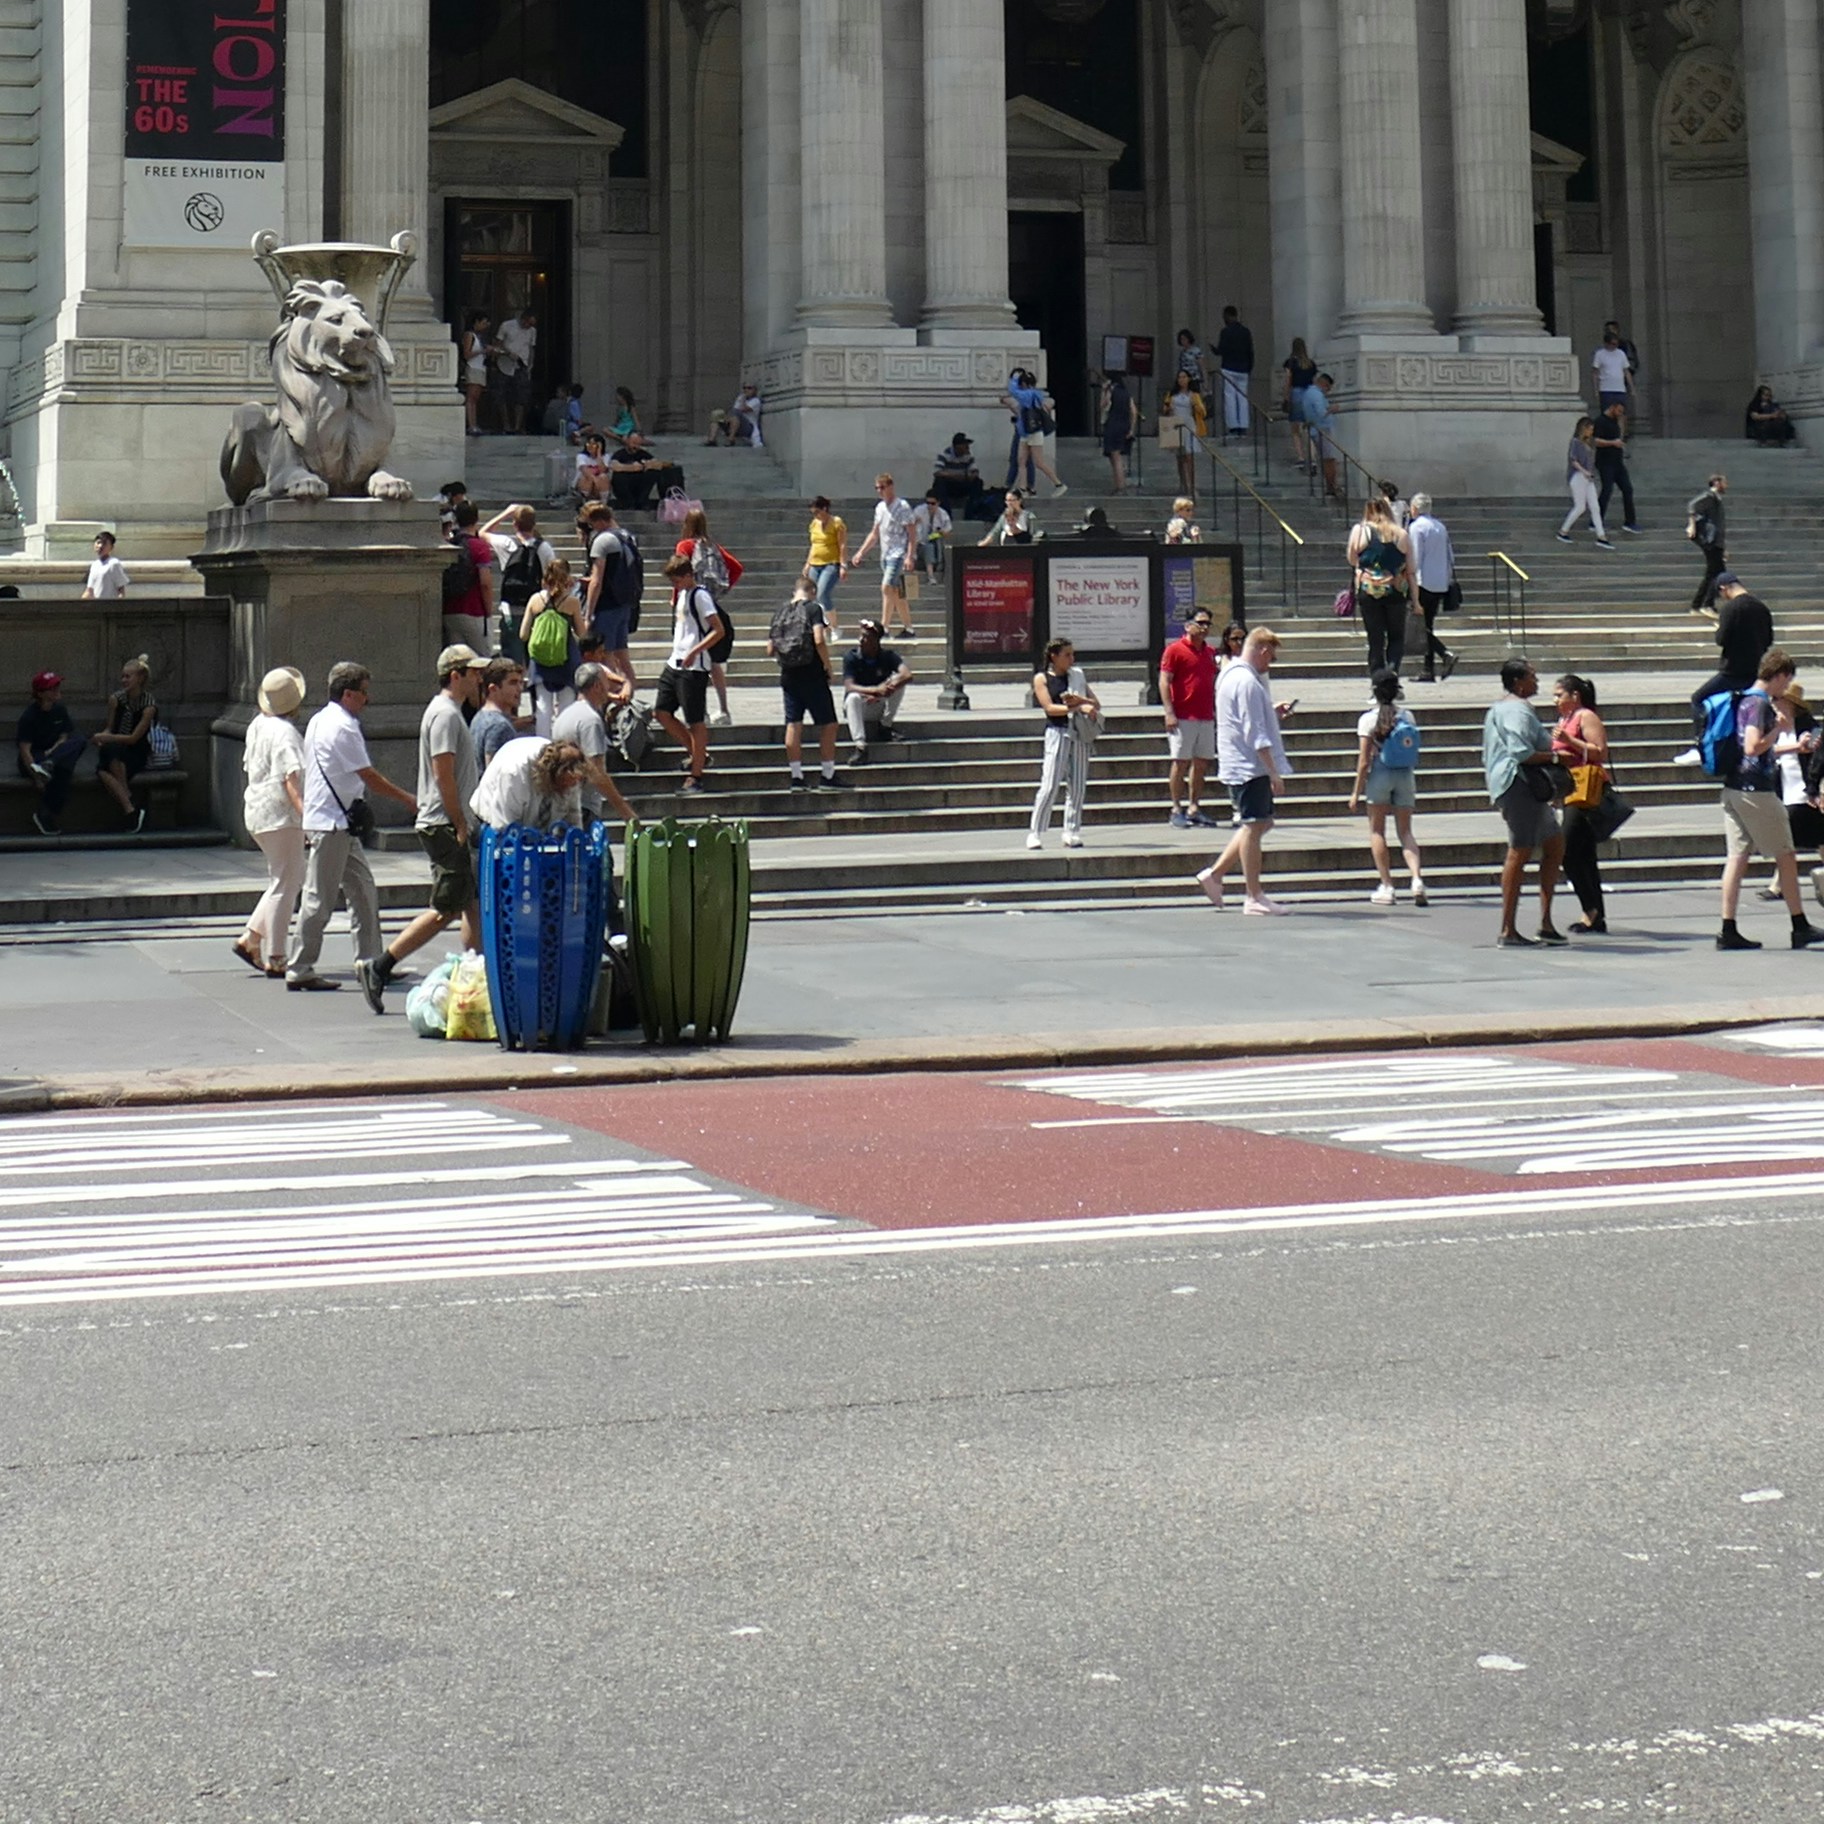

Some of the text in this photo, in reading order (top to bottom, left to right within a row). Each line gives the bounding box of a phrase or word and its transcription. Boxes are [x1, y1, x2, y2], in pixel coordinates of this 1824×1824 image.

[135, 78, 188, 104] THE
[134, 104, 190, 133] 60s
[144, 165, 266, 181] FREE EXHIBITION
[966, 579, 1029, 589] Mid-Manhattan
[1056, 578, 1142, 591] The New York
[966, 589, 997, 601] Library
[1057, 593, 1142, 609] Public Library
